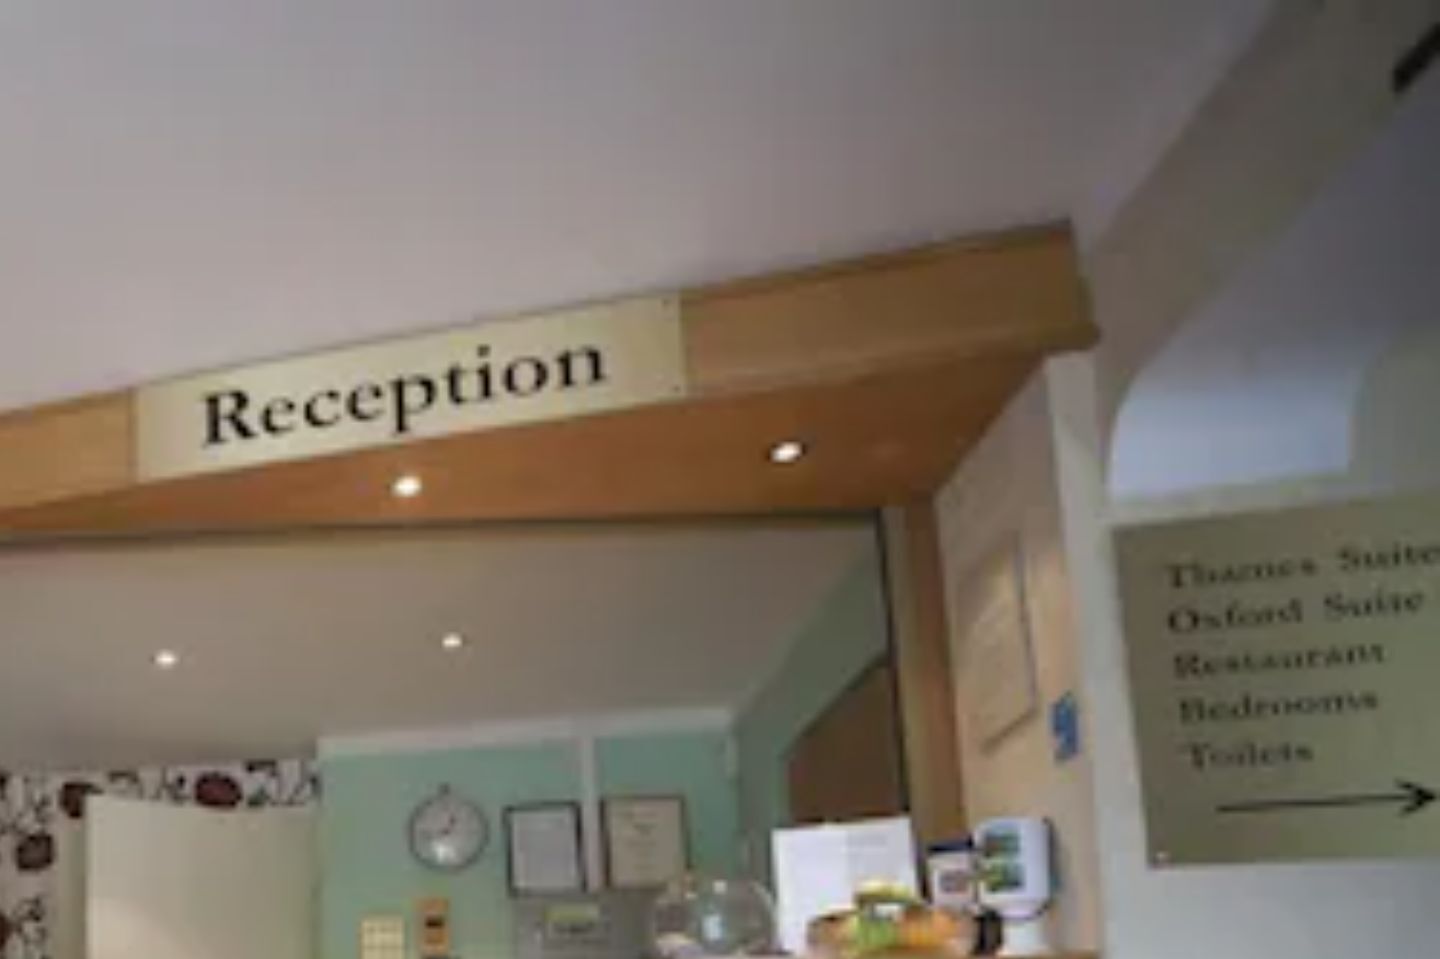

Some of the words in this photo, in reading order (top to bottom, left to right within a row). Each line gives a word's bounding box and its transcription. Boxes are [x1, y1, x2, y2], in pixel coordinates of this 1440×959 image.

[202, 344, 607, 446] Reception
[1337, 541, 1440, 573] Suite
[1168, 599, 1304, 635] Oxford
[1323, 588, 1425, 622] Suite
[1172, 642, 1386, 680] Restaurant
[1177, 690, 1379, 725] Bedrooms
[1183, 743, 1315, 770] Toilets
